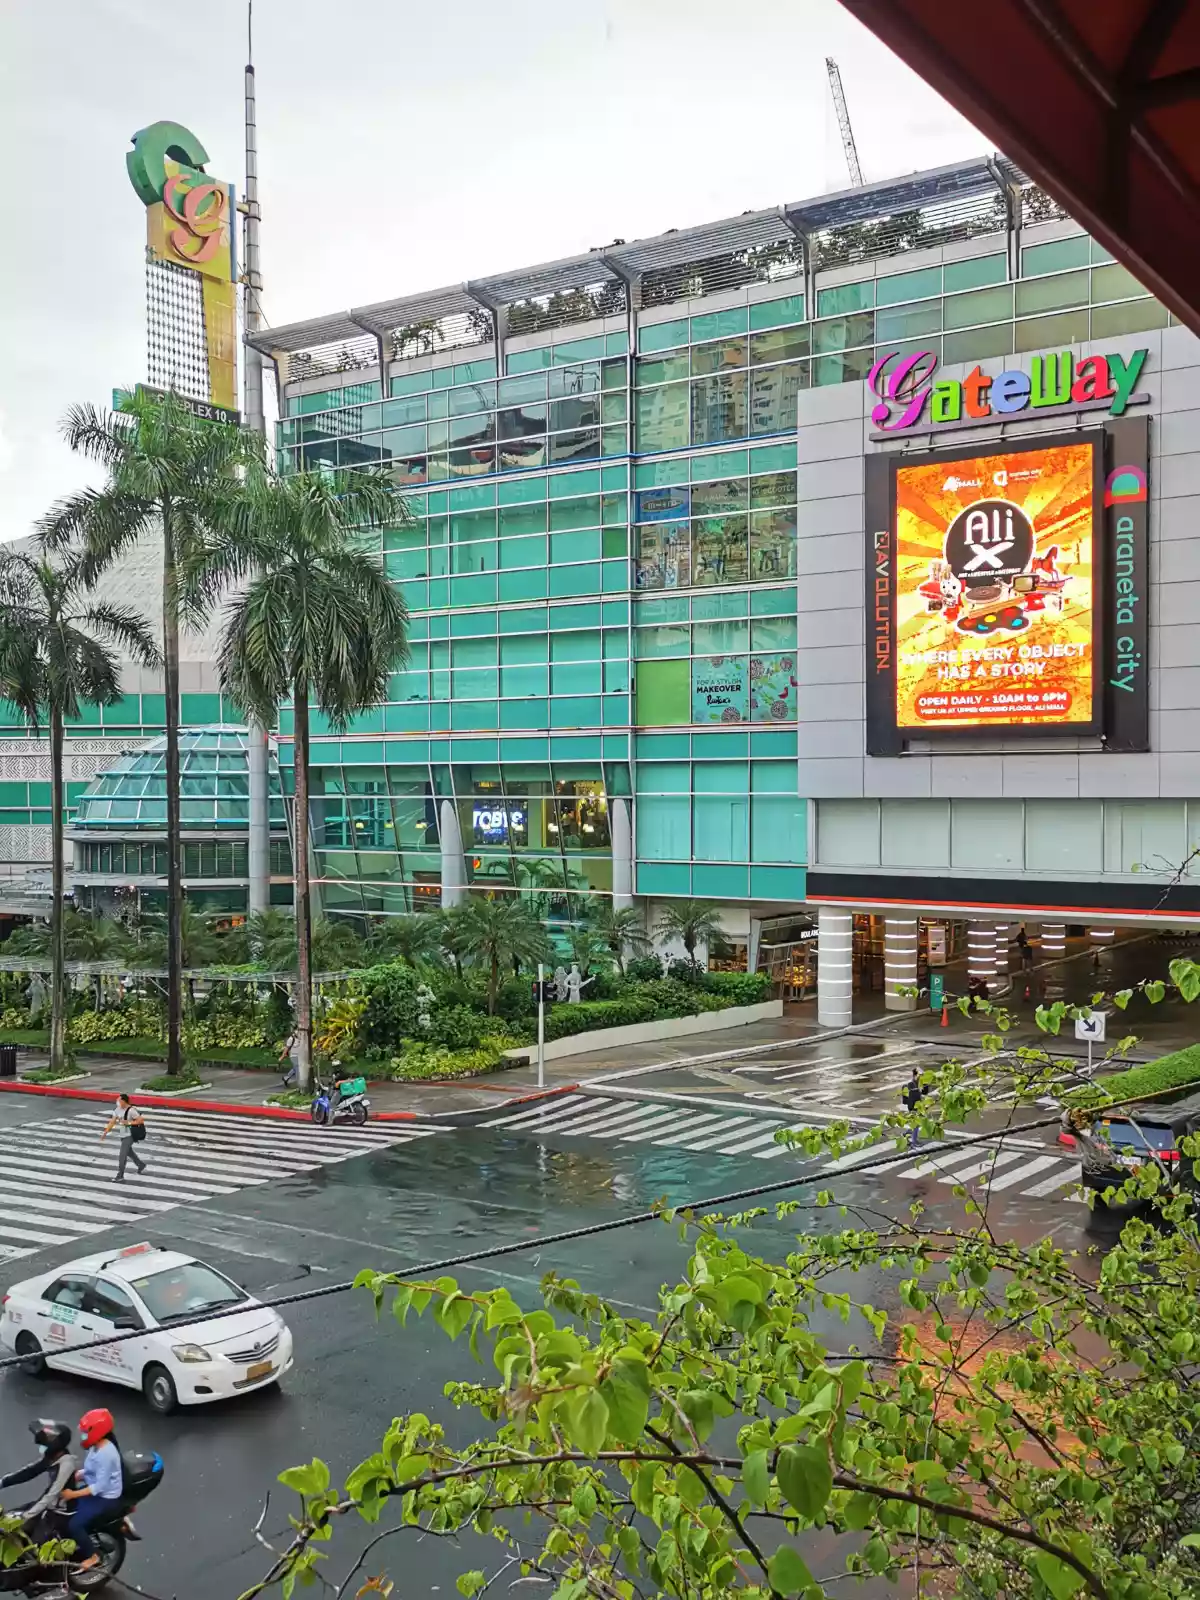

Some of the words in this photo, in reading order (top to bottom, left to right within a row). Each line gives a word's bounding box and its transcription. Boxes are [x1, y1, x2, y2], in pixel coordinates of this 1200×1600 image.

[214, 410, 227, 422] 10
[964, 509, 1015, 545] Ali
[1116, 516, 1139, 624] araneta
[901, 650, 958, 665] WHERE
[961, 647, 1015, 662] EVERY
[1018, 643, 1087, 659] OBJECT
[1110, 636, 1141, 692] city
[937, 665, 971, 680] HAS
[975, 665, 987, 677] A
[990, 662, 1046, 677] STORY
[696, 684, 742, 694] MAKEOVER
[918, 696, 948, 706] OPEN
[950, 695, 983, 705] DAILY
[992, 693, 1024, 703] 10AM
[1042, 691, 1067, 702] 6PM
